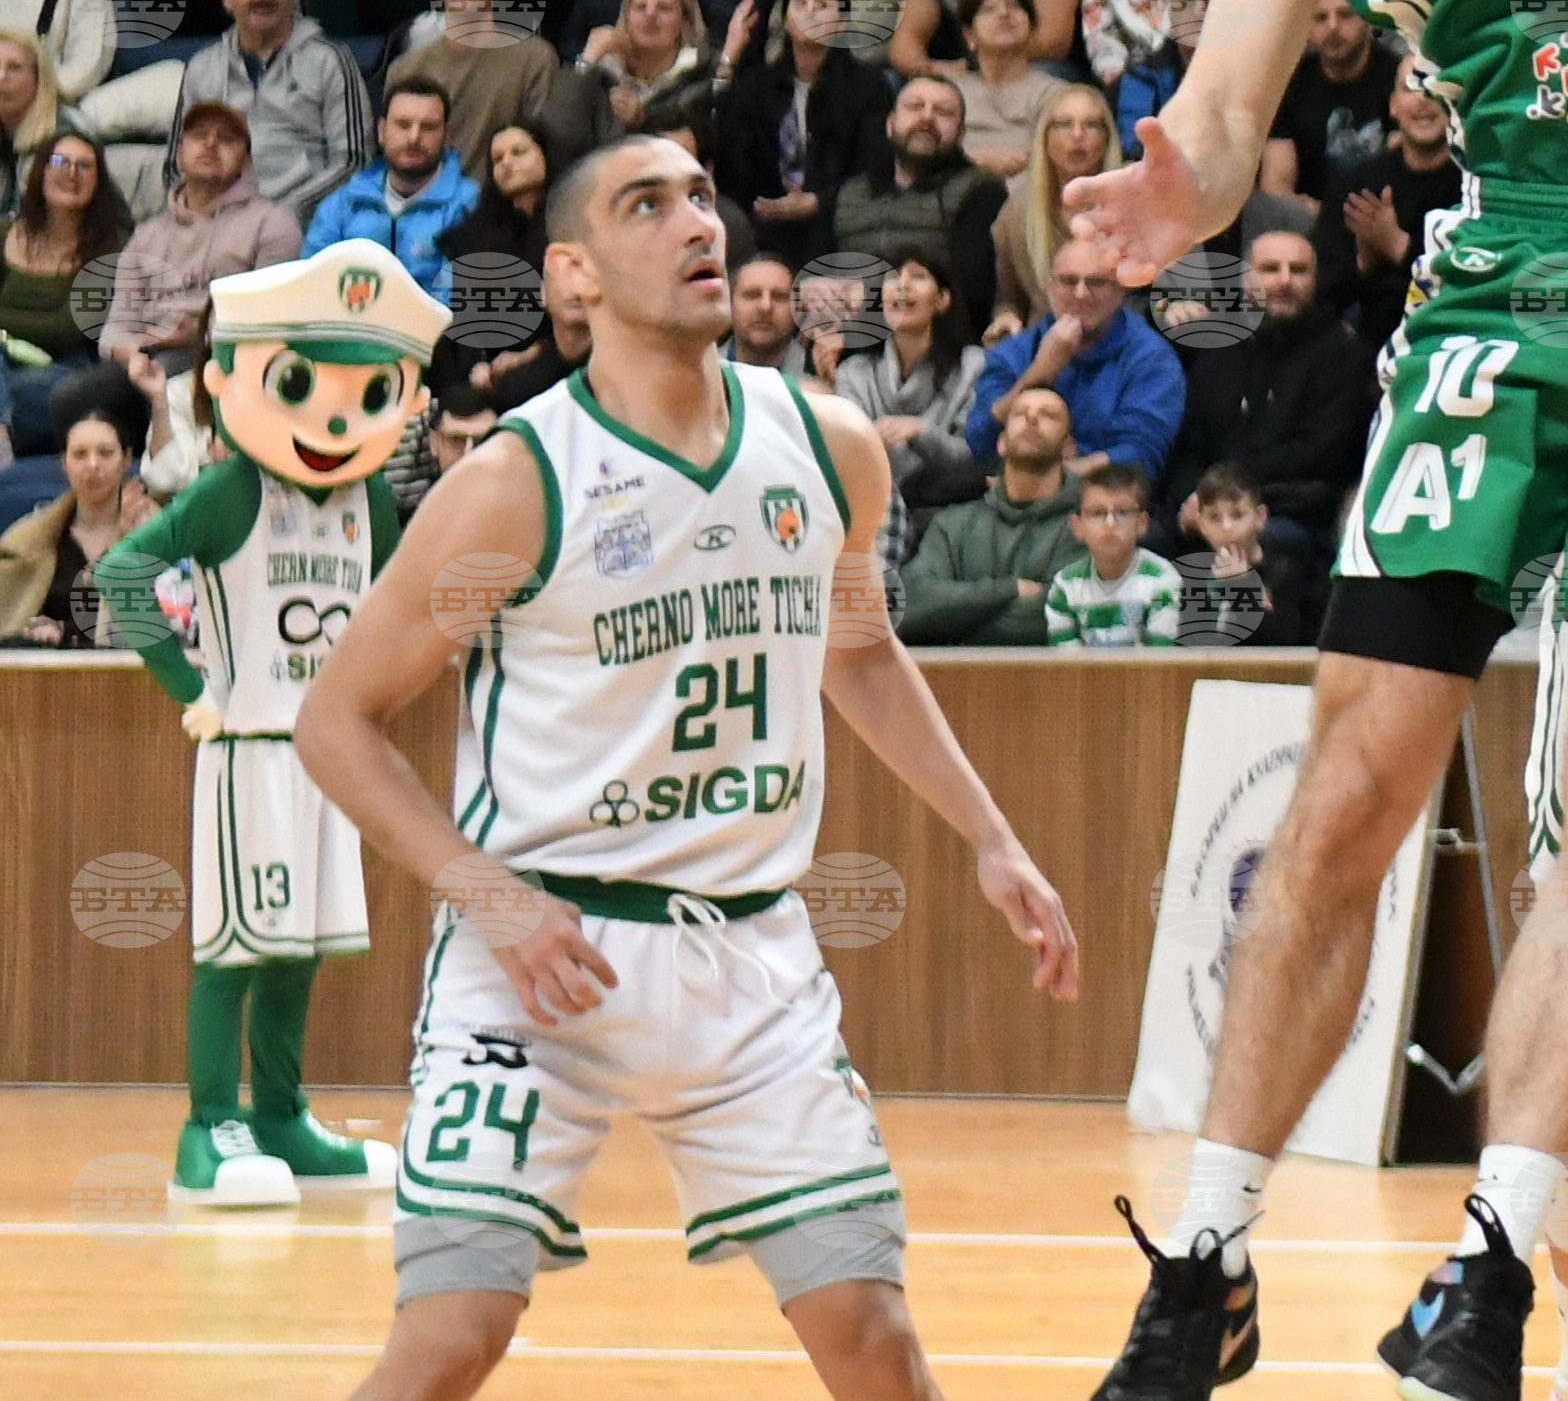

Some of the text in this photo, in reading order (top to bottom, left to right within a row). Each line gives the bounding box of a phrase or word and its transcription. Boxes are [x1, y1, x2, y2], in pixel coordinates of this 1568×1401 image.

[1413, 335, 1519, 418] 10
[593, 587, 694, 667] CHERNO
[700, 576, 760, 641] MORE
[672, 652, 768, 753] 24
[644, 759, 805, 823] SIGDA
[251, 861, 291, 911] 13
[425, 1080, 540, 1173] 24
